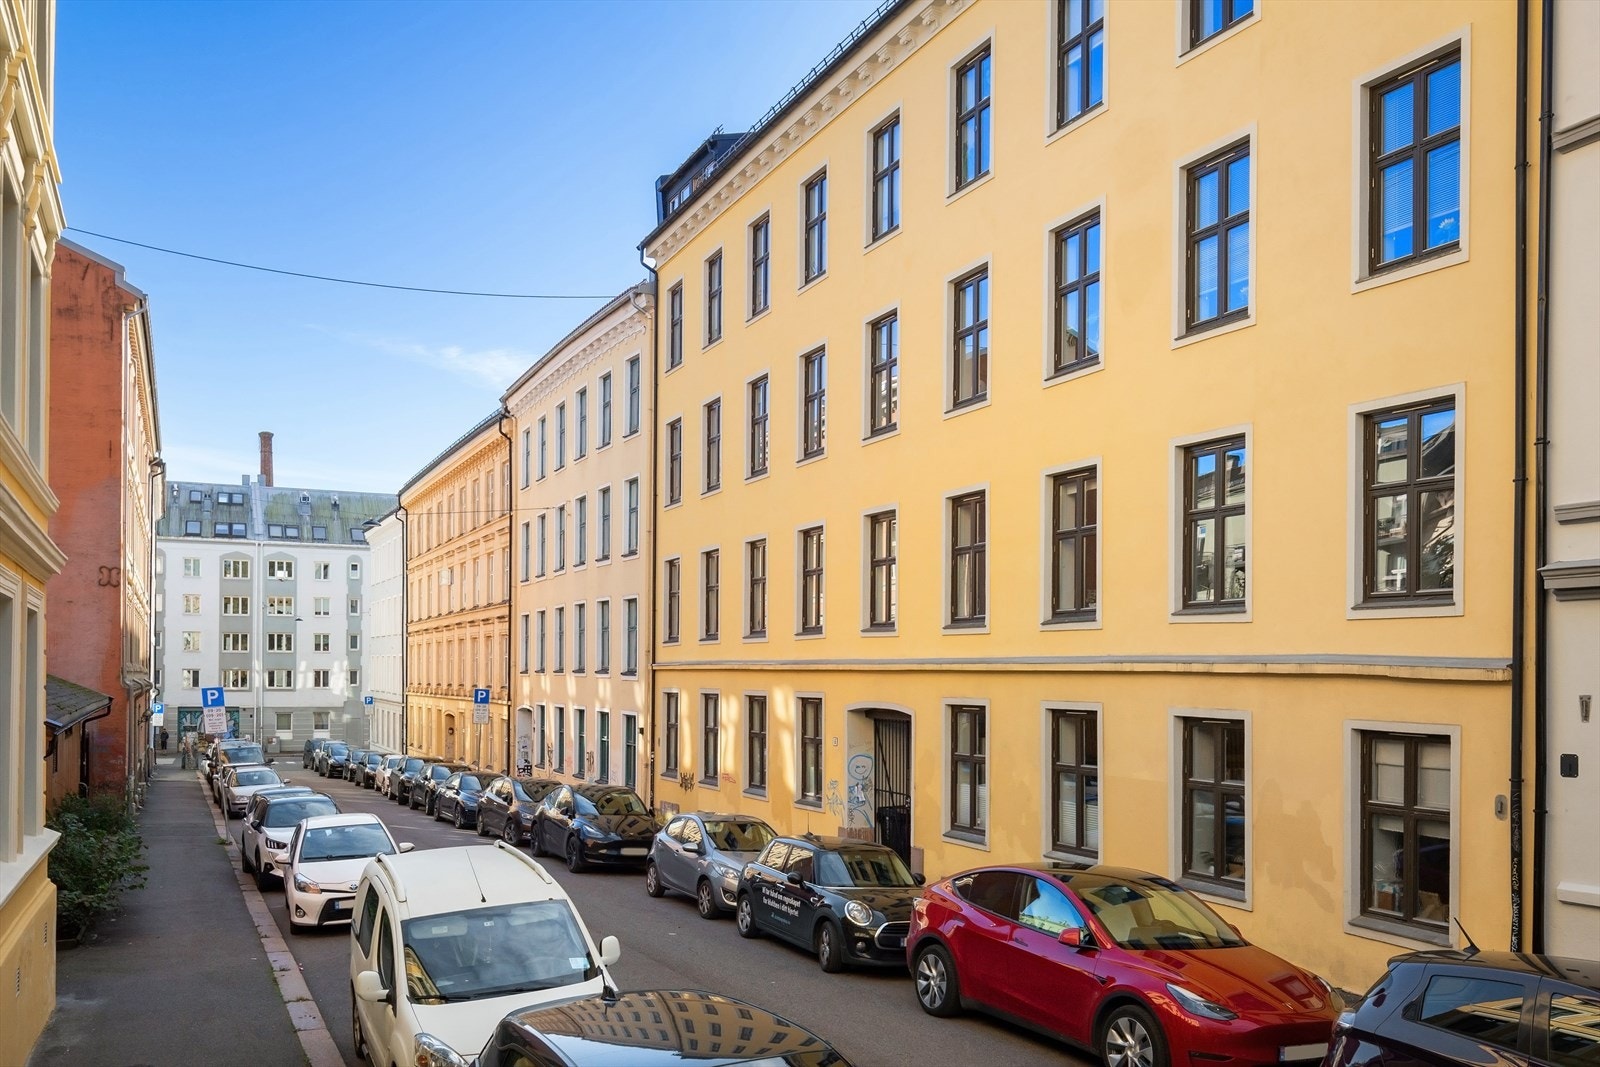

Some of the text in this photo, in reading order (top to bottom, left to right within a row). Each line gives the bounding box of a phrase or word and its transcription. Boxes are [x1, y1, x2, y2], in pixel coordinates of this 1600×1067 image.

[207, 690, 219, 705] P
[478, 691, 486, 702] P
[155, 704, 162, 712] P
